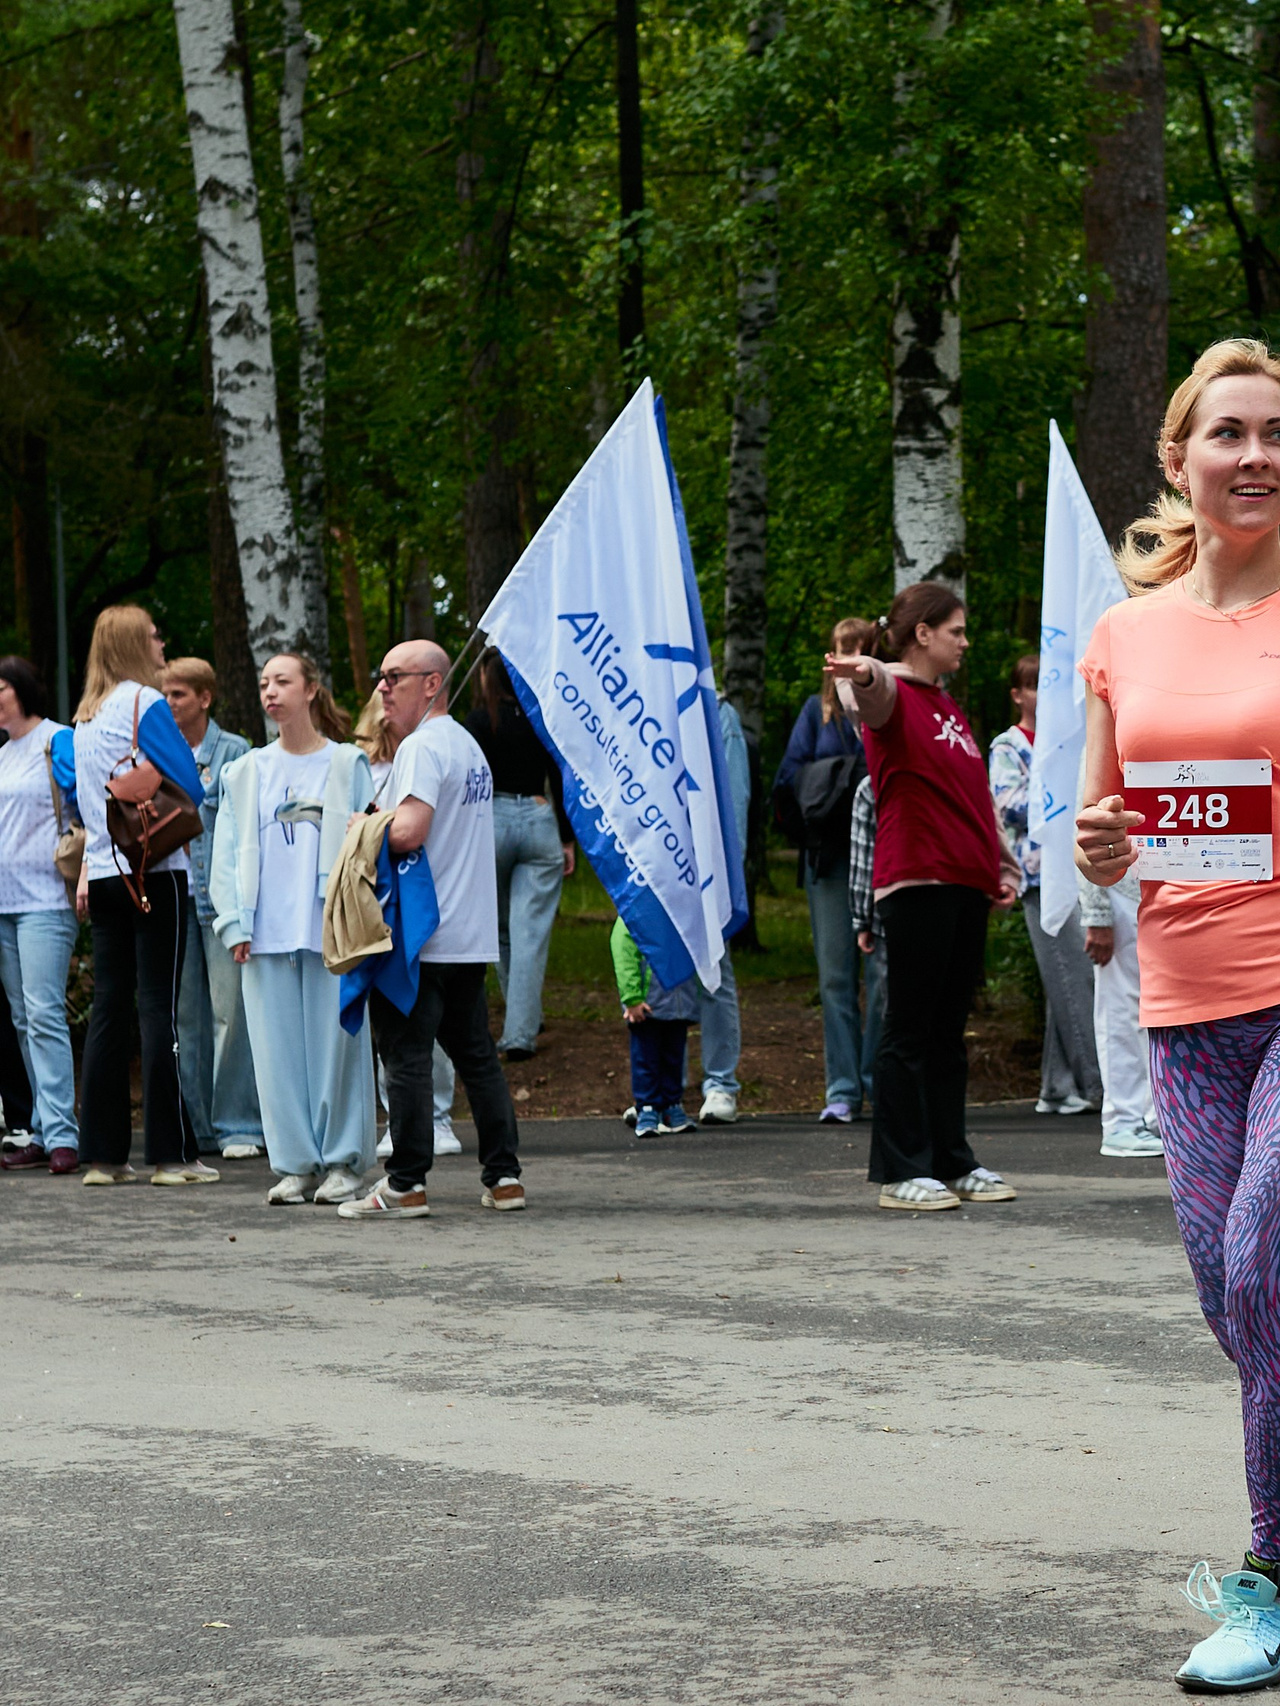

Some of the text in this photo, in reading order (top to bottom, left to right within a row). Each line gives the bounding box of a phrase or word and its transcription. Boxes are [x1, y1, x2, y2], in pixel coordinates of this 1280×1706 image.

[557, 611, 675, 770] Alliance
[553, 671, 647, 805] consulting
[637, 804, 696, 887] group
[1157, 793, 1229, 829] 248
[1238, 1578, 1258, 1589] NIKE
